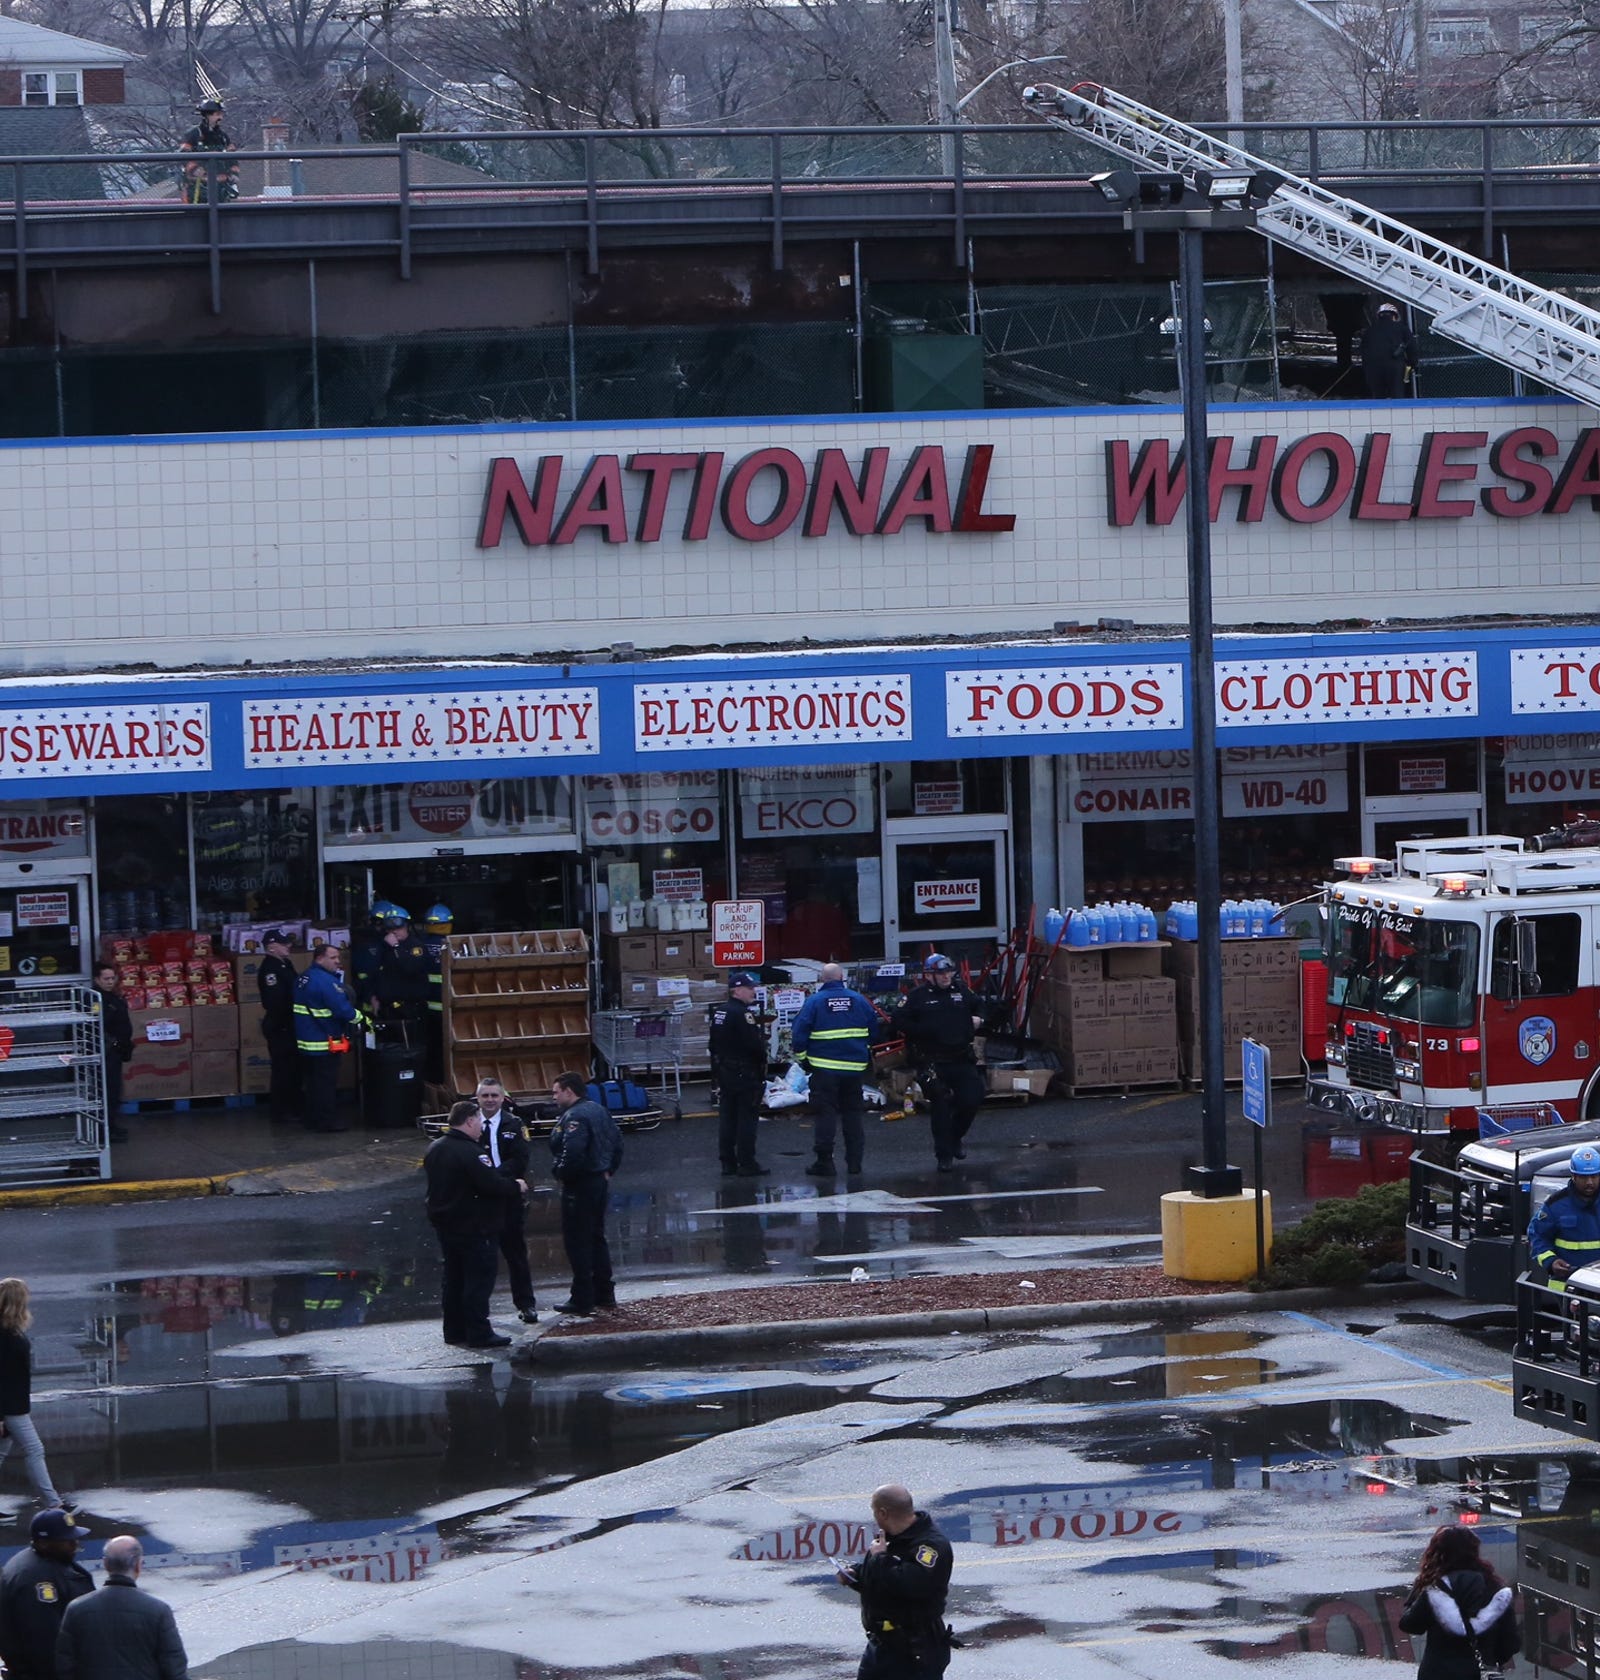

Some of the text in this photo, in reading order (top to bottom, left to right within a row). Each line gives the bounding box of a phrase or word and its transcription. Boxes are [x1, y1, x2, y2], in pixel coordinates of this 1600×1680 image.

[476, 443, 1017, 549] NATIONAL
[1220, 666, 1473, 712] CLOTHING
[967, 679, 1164, 722] FOODS
[640, 689, 905, 737] ELECTRONICS
[249, 702, 593, 752] HEALTH & BEAUTY
[413, 781, 467, 797] DO NOT
[1074, 786, 1191, 813] CONAIR
[1241, 779, 1327, 809] WD-40
[479, 776, 563, 829] ONLY
[419, 805, 467, 823] ENTER
[590, 807, 715, 836] COSCO
[757, 797, 857, 832] EKCO
[917, 882, 978, 897] ENTRANCE
[724, 905, 754, 914] PICK-UP
[731, 914, 747, 922] AND
[1338, 905, 1373, 929] Pride Of
[720, 922, 758, 932] DROP-OFF
[1381, 913, 1395, 931] The
[729, 932, 748, 940] ONLY
[733, 942, 745, 951] NO
[722, 951, 756, 961] PARKING
[1426, 1038, 1450, 1052] 73
